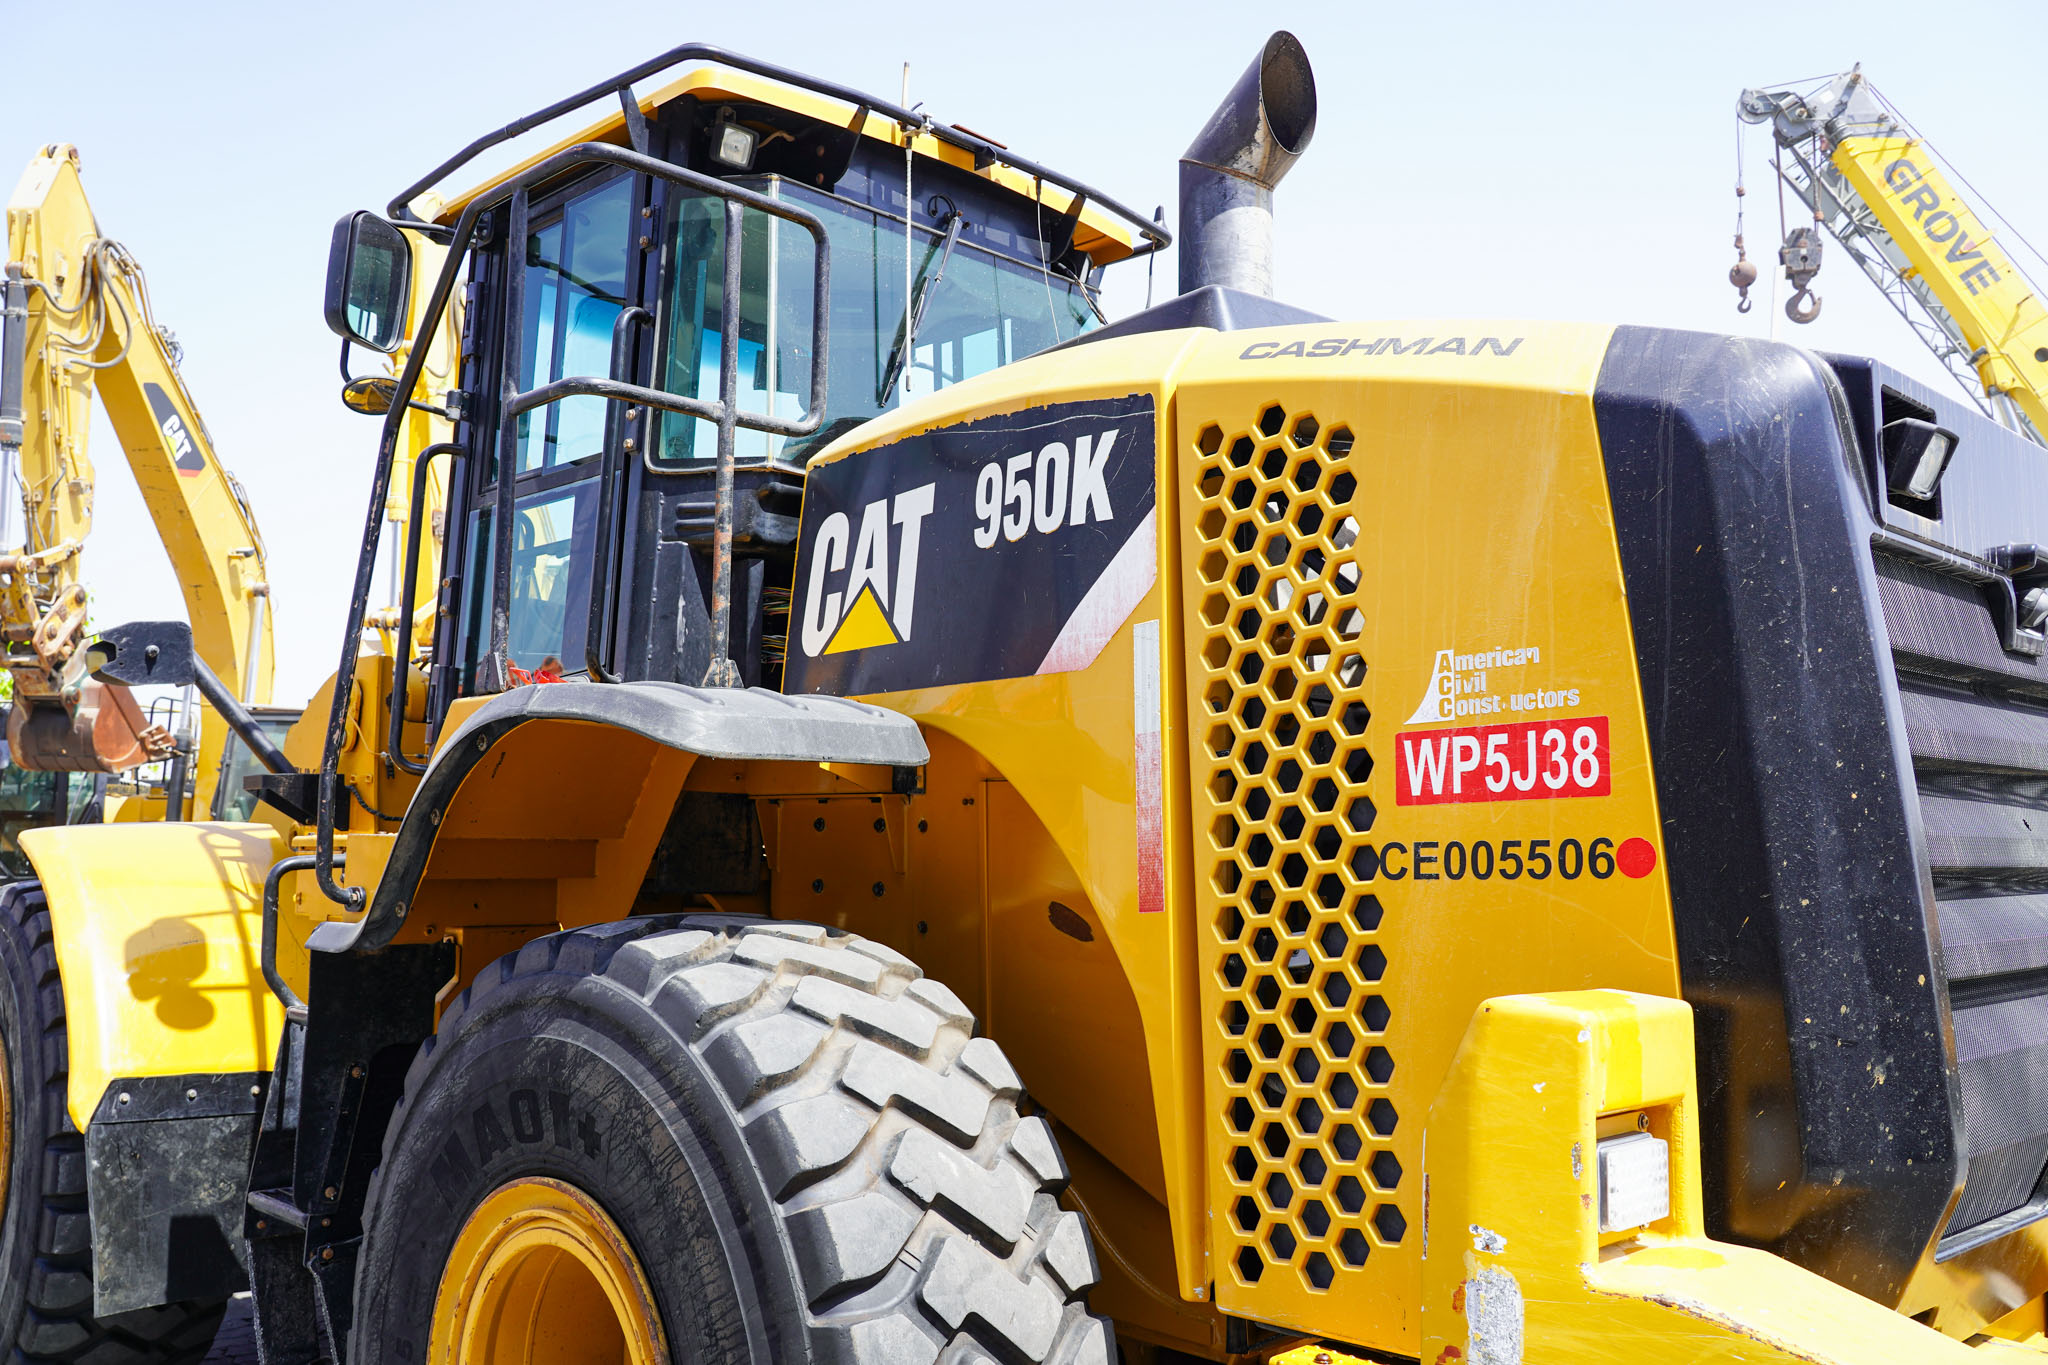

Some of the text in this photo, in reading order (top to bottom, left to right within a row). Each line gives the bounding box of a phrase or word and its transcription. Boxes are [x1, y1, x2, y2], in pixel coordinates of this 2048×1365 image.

[1884, 159, 2001, 296] GROVE
[1239, 337, 1525, 361] CASHMAN
[162, 414, 193, 462] CAT
[973, 429, 1120, 549] 950K
[801, 482, 936, 657] CAT
[1436, 646, 1540, 675] American
[1437, 672, 1487, 697] Civil
[1437, 687, 1580, 720] Constuctors
[1403, 726, 1600, 797] WP5J38
[1379, 837, 1616, 881] CE005506
